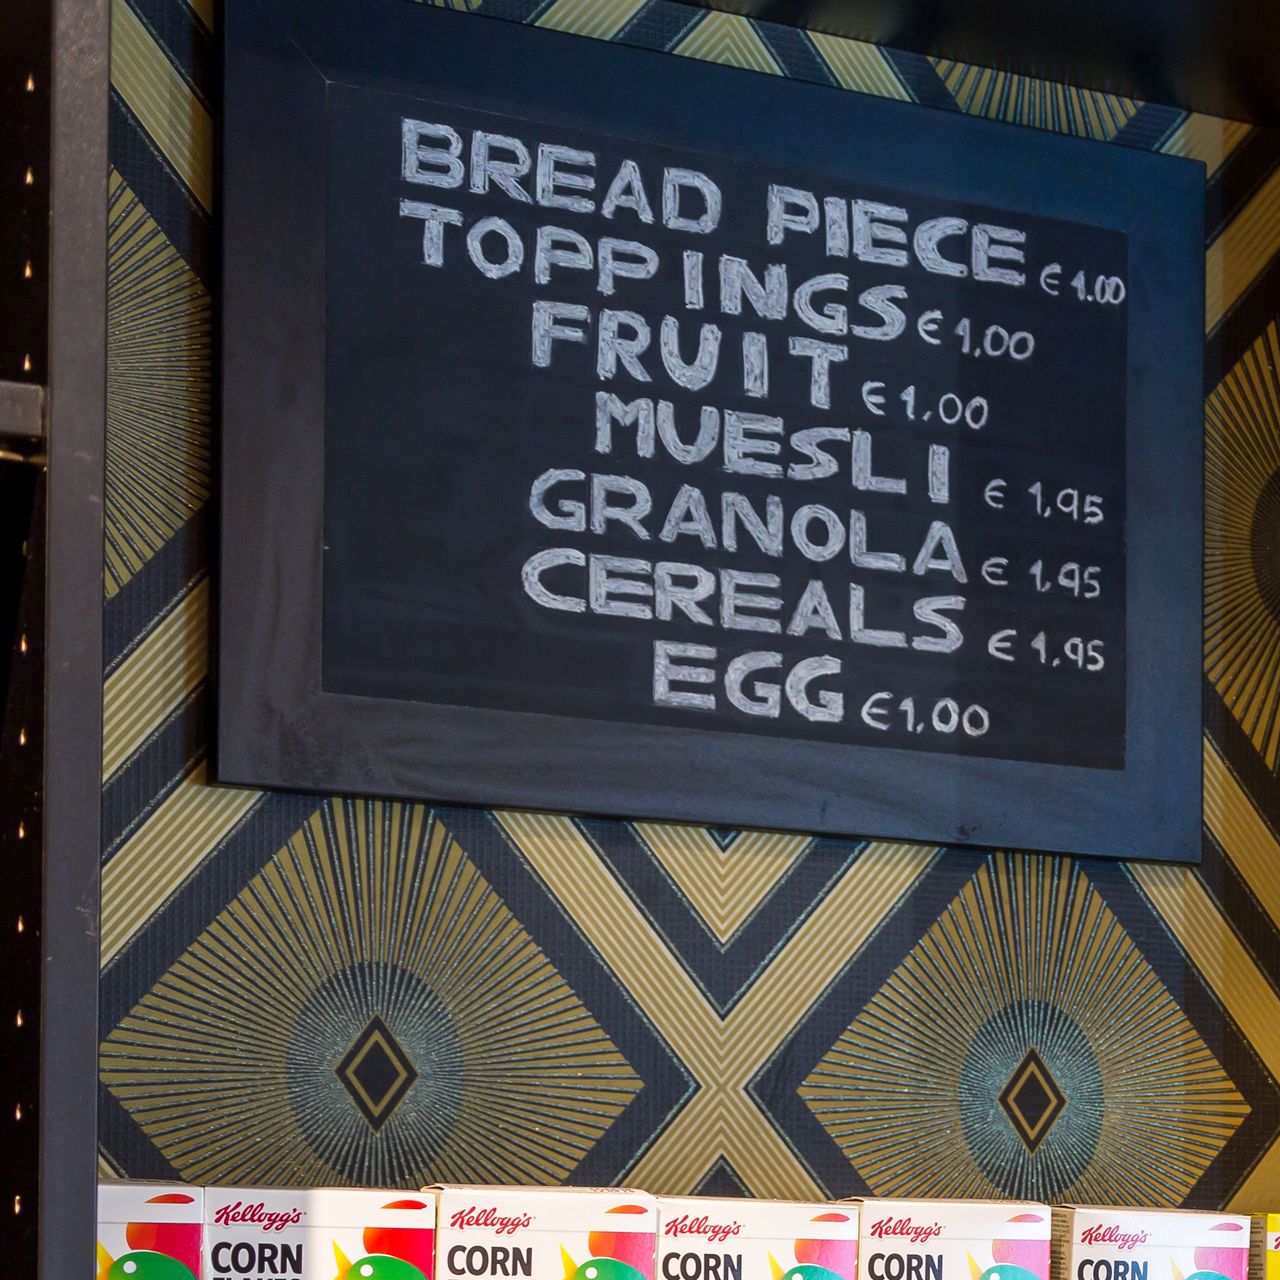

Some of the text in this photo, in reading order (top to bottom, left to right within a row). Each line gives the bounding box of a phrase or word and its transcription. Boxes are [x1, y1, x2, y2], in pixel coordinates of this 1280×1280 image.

[401, 117, 722, 233] BREAD
[767, 184, 1027, 286] PIECE
[400, 197, 907, 340] TOPPINGS
[531, 300, 849, 411] FRUIT
[594, 392, 949, 504] MUESLI
[529, 467, 968, 585] GRANOLA
[522, 547, 966, 654] CEREALS
[652, 640, 843, 723] EGG
[214, 1201, 302, 1231] Kellogg's
[450, 1206, 532, 1235] Kellogg's
[664, 1213, 741, 1242] Kellogg's
[871, 1217, 944, 1243] Kellogg's
[1081, 1224, 1147, 1250] Kellogg's
[211, 1242, 303, 1275] CORN
[447, 1244, 532, 1277] CORN
